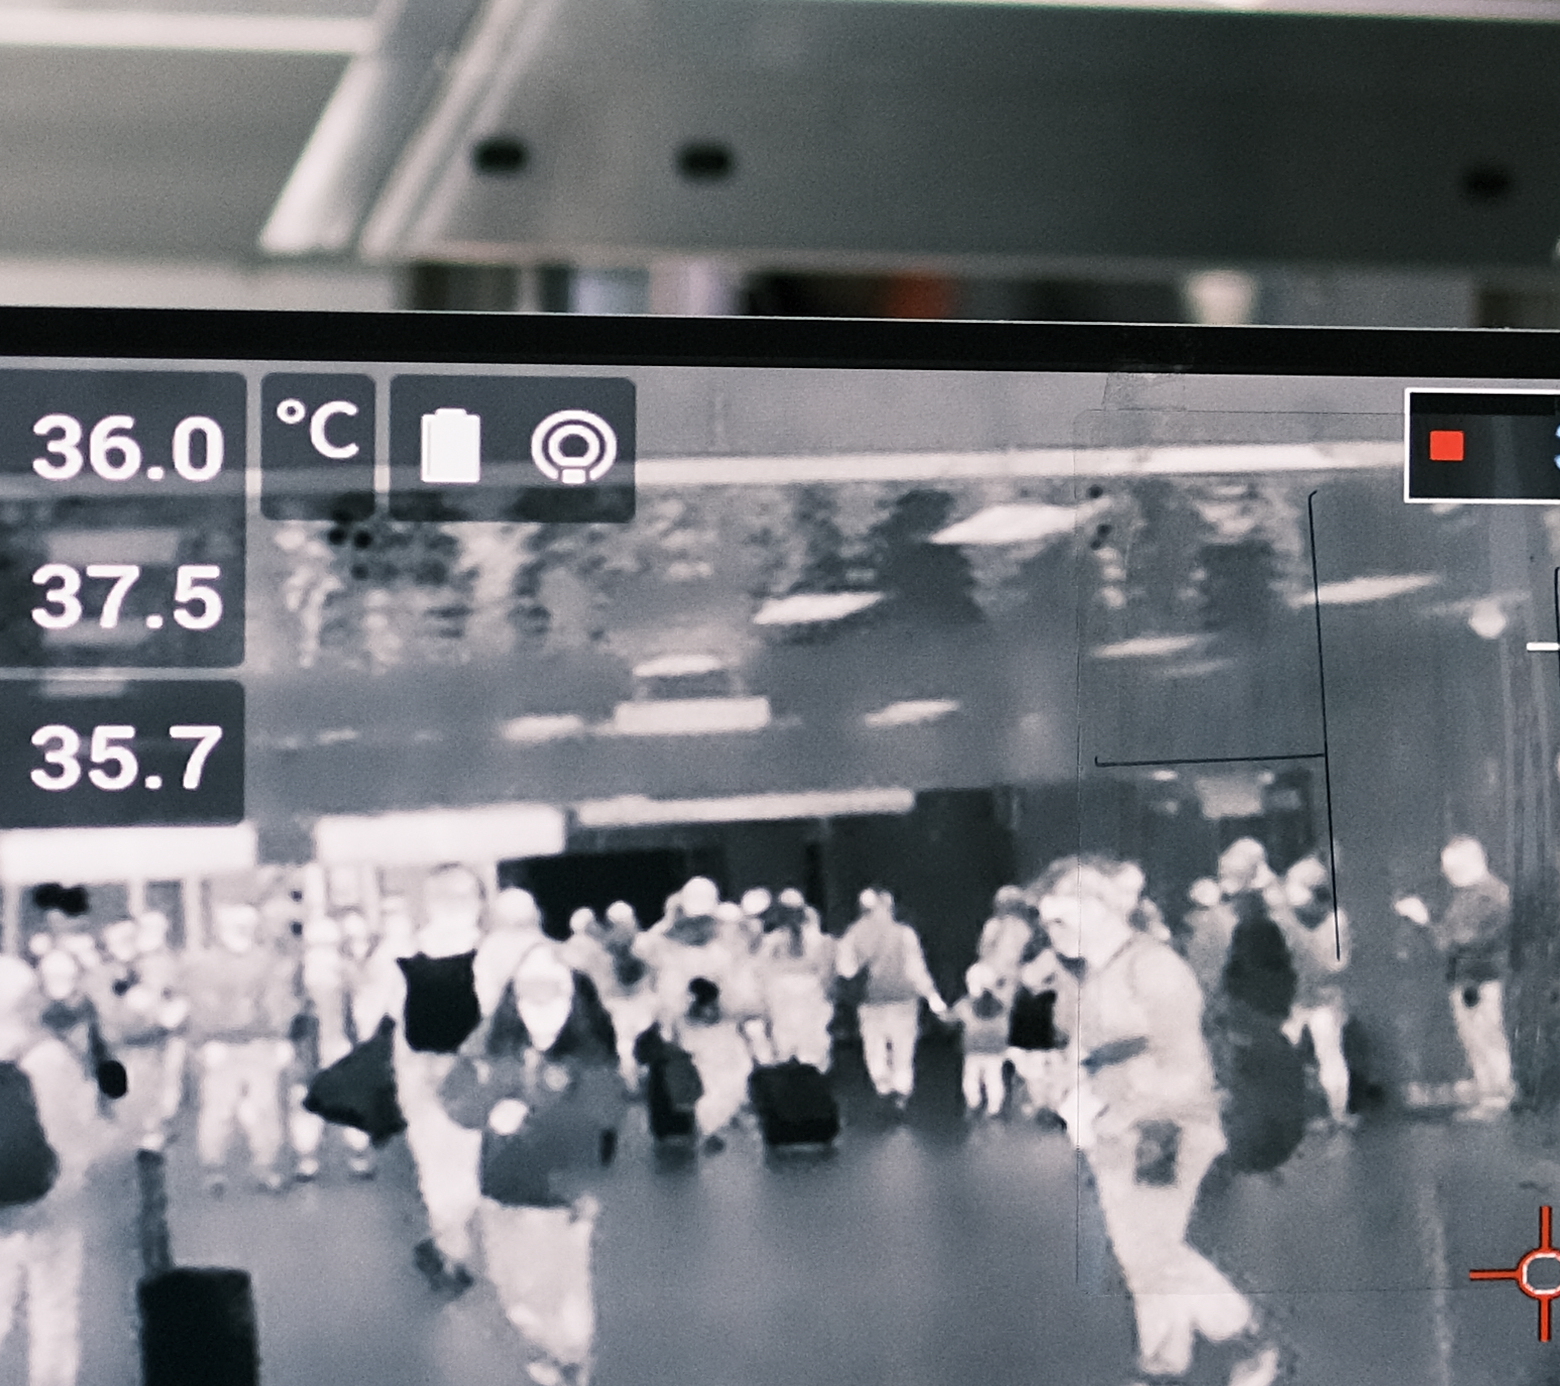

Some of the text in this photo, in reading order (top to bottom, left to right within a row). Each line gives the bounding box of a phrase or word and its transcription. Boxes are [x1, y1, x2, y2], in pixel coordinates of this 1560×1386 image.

[31, 413, 225, 481] 36.0
[276, 398, 360, 460] °C
[30, 564, 223, 631] 37.5
[29, 724, 224, 791] 35.7
